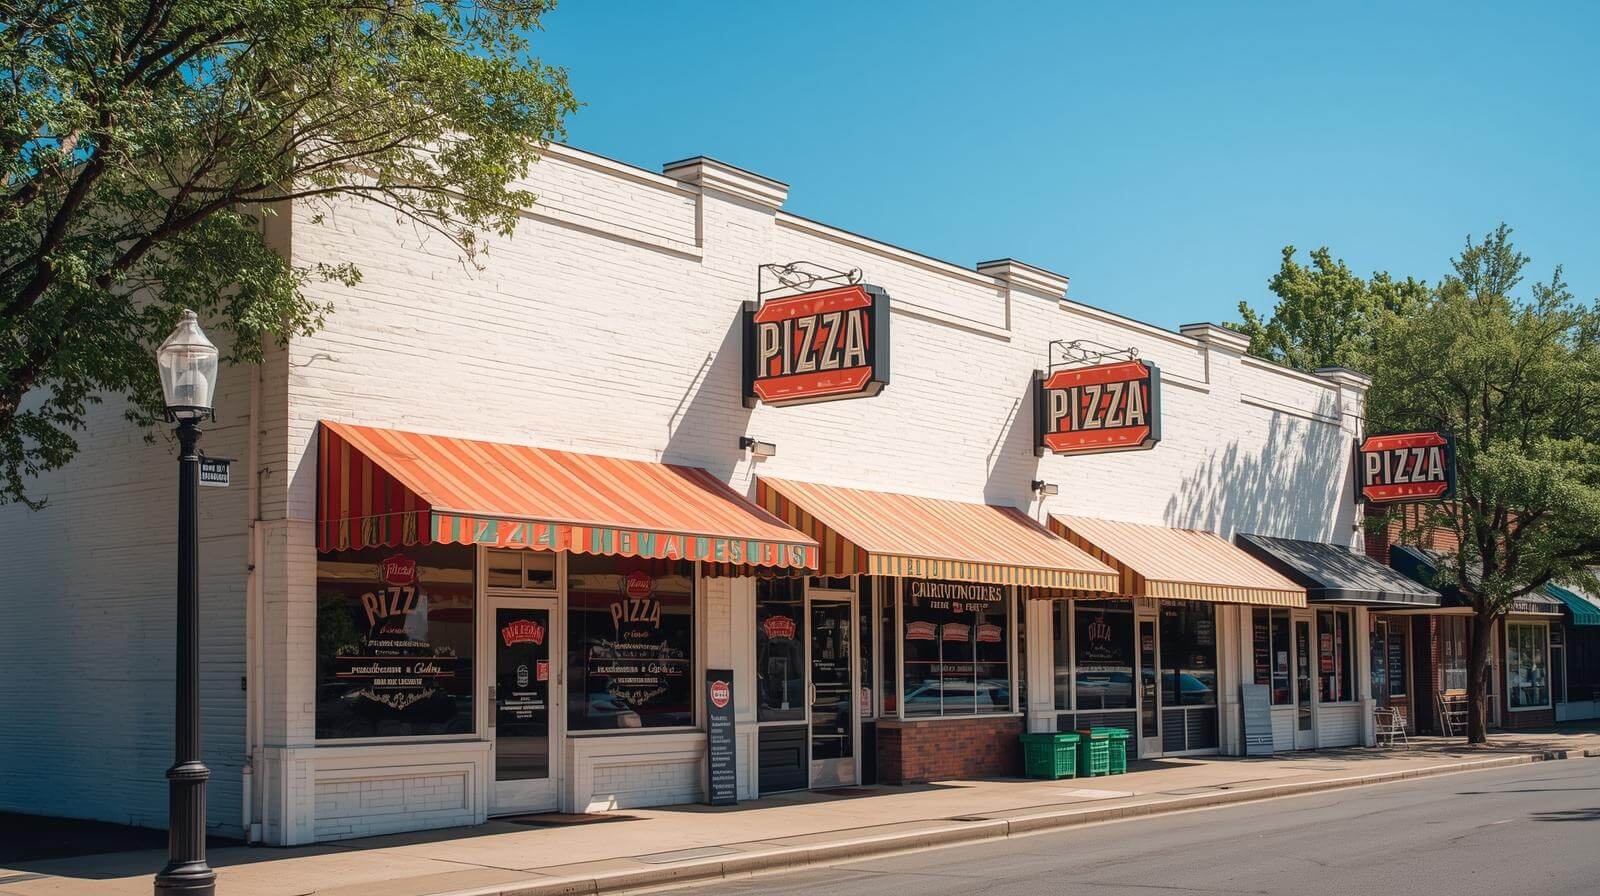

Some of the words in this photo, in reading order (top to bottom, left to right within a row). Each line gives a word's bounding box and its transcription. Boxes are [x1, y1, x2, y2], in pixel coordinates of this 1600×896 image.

[758, 309, 866, 377] PIZZA
[1050, 380, 1145, 433] PIZZA
[1366, 447, 1445, 485] PIZZA
[610, 599, 662, 630] PIZZA
